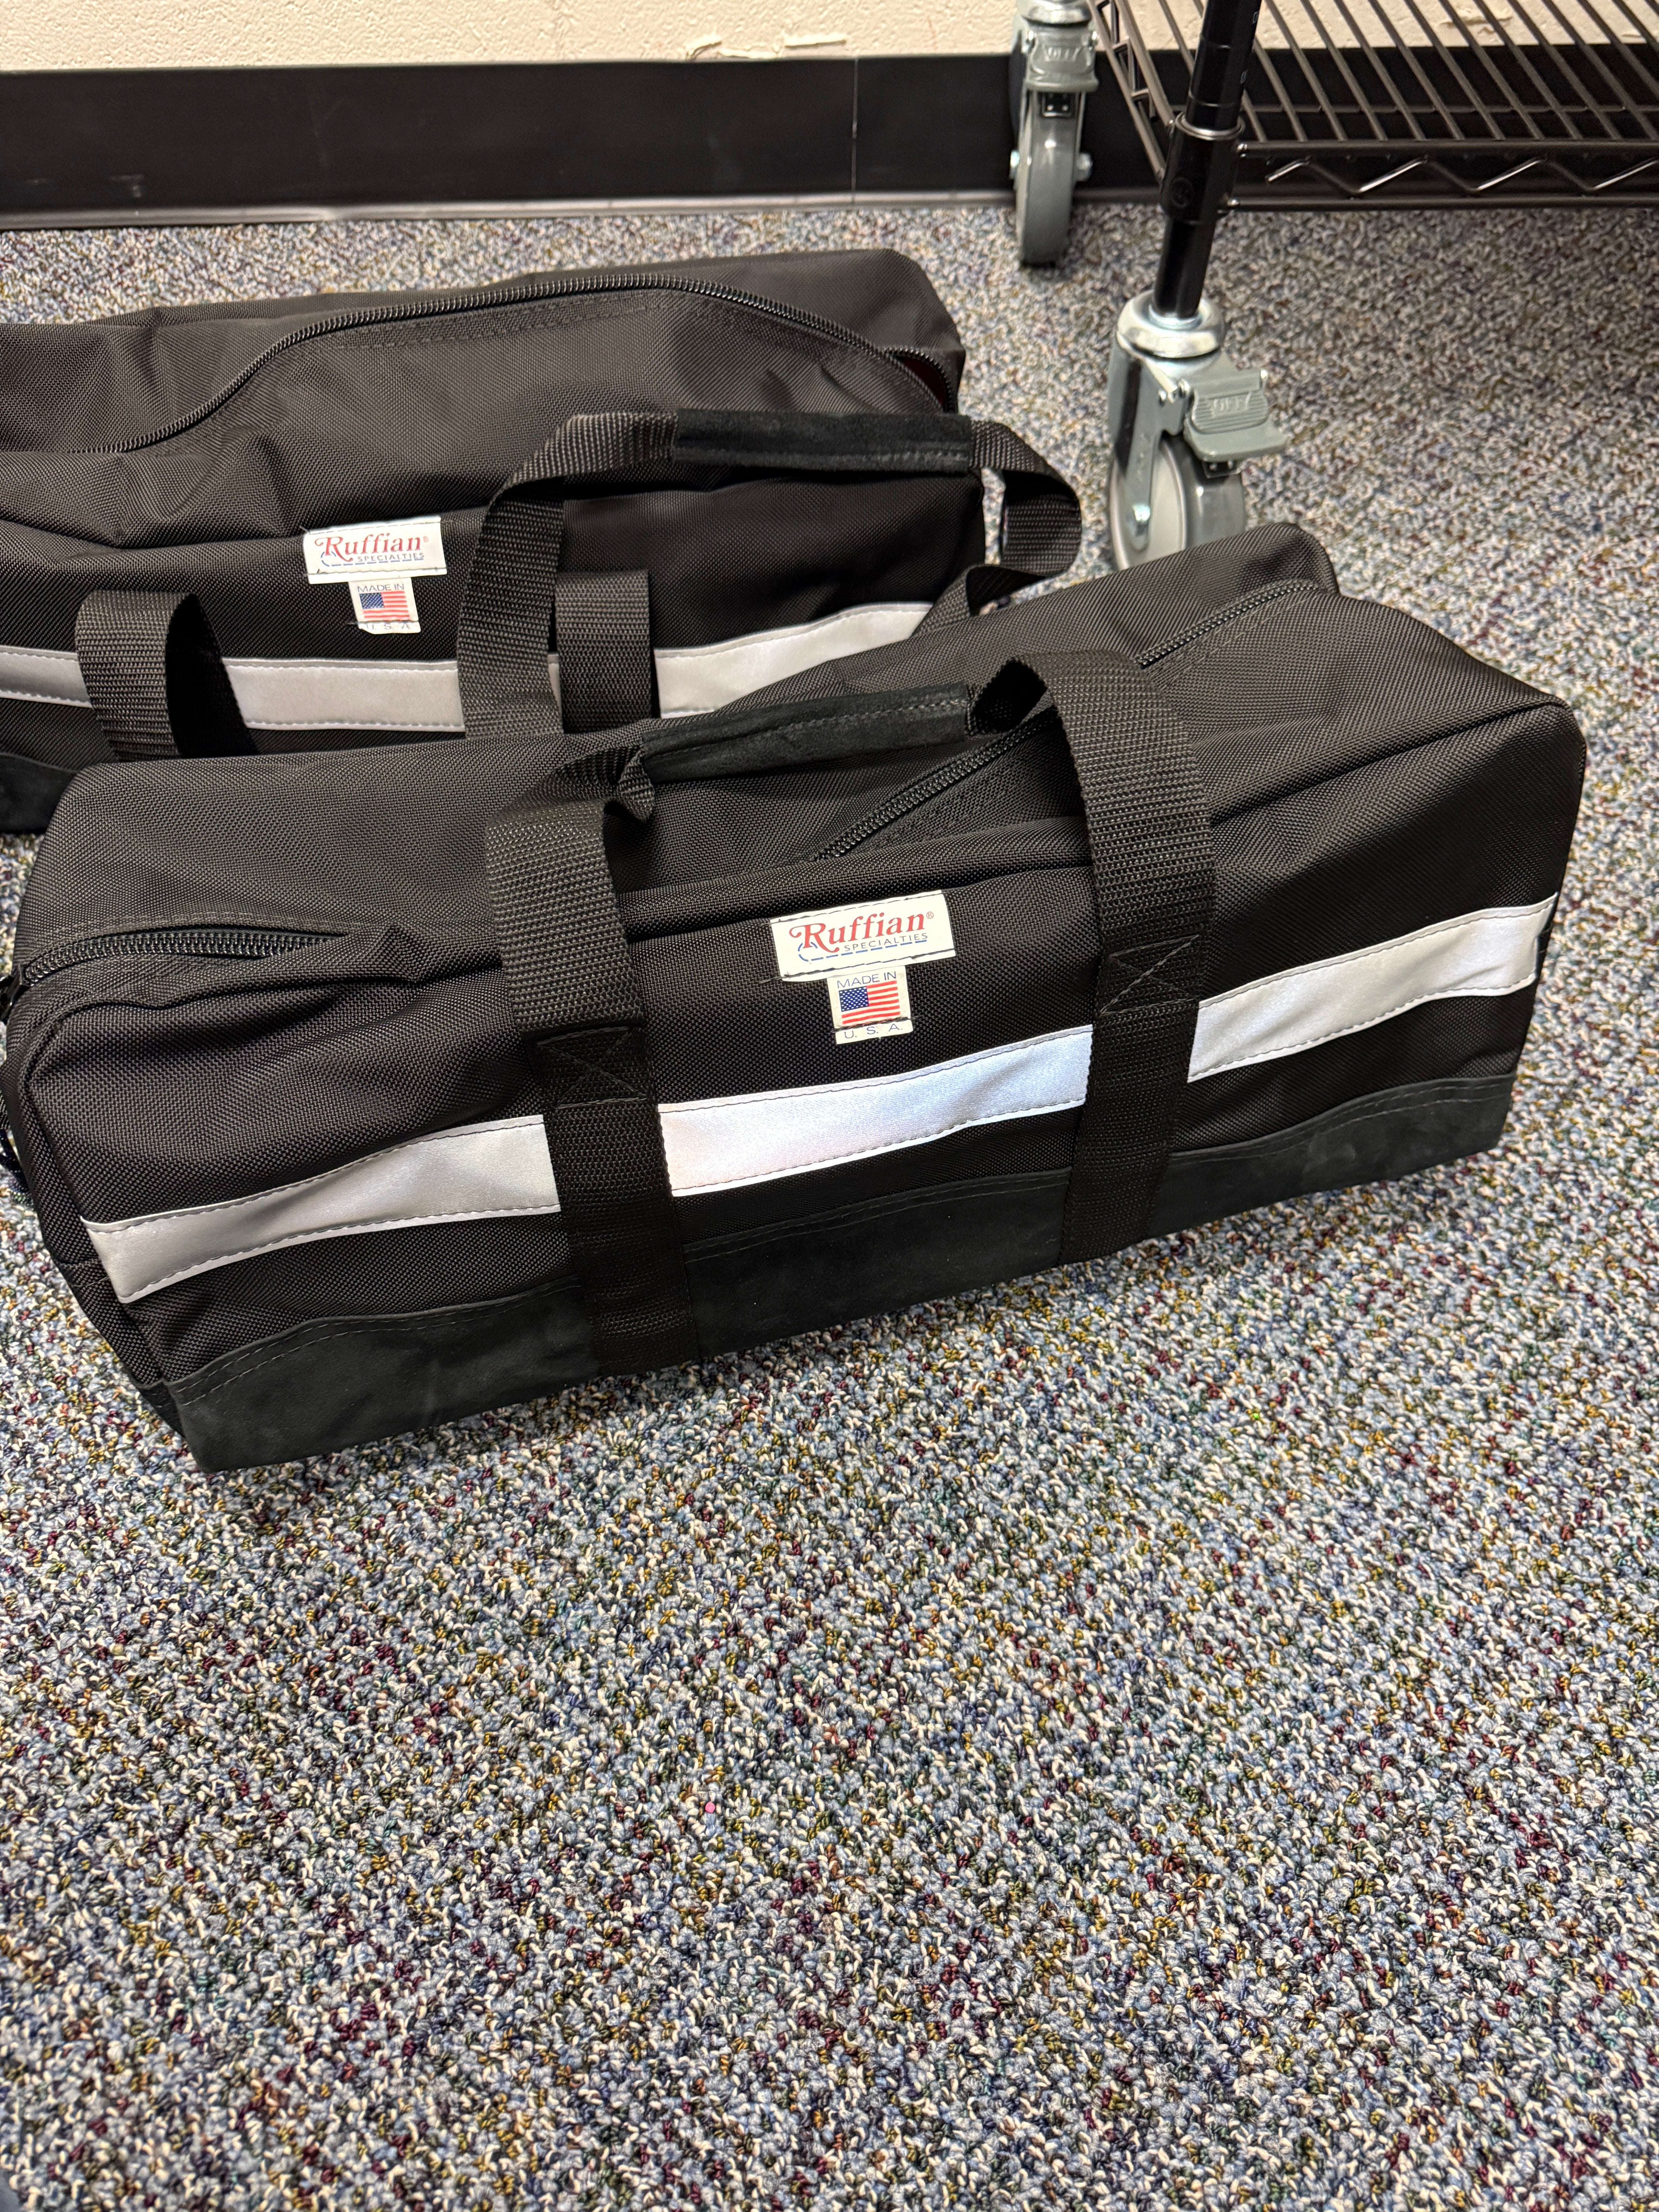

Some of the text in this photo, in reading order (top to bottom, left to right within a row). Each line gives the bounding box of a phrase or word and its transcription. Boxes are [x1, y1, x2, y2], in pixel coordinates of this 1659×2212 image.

[357, 552, 425, 562] SPECIALTIES
[357, 584, 392, 592] MADE
[844, 933, 928, 951] SPECIALTIES
[836, 971, 897, 989] MADE IN
